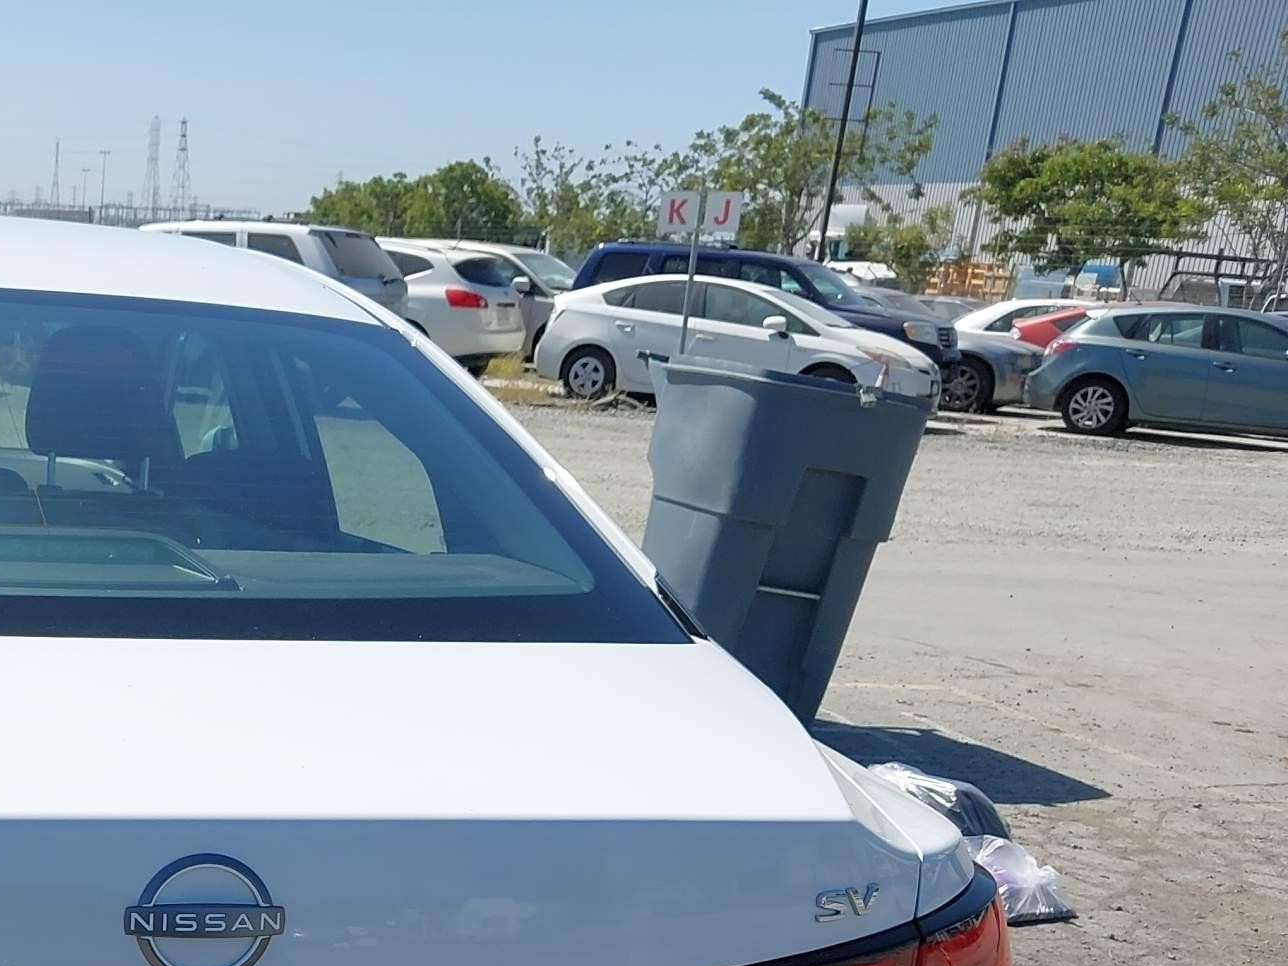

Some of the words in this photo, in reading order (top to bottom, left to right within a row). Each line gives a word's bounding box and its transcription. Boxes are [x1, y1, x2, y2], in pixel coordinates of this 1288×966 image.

[668, 199, 688, 225] K
[713, 199, 731, 225] J
[814, 882, 880, 922] SV
[130, 912, 281, 932] NISSAN
